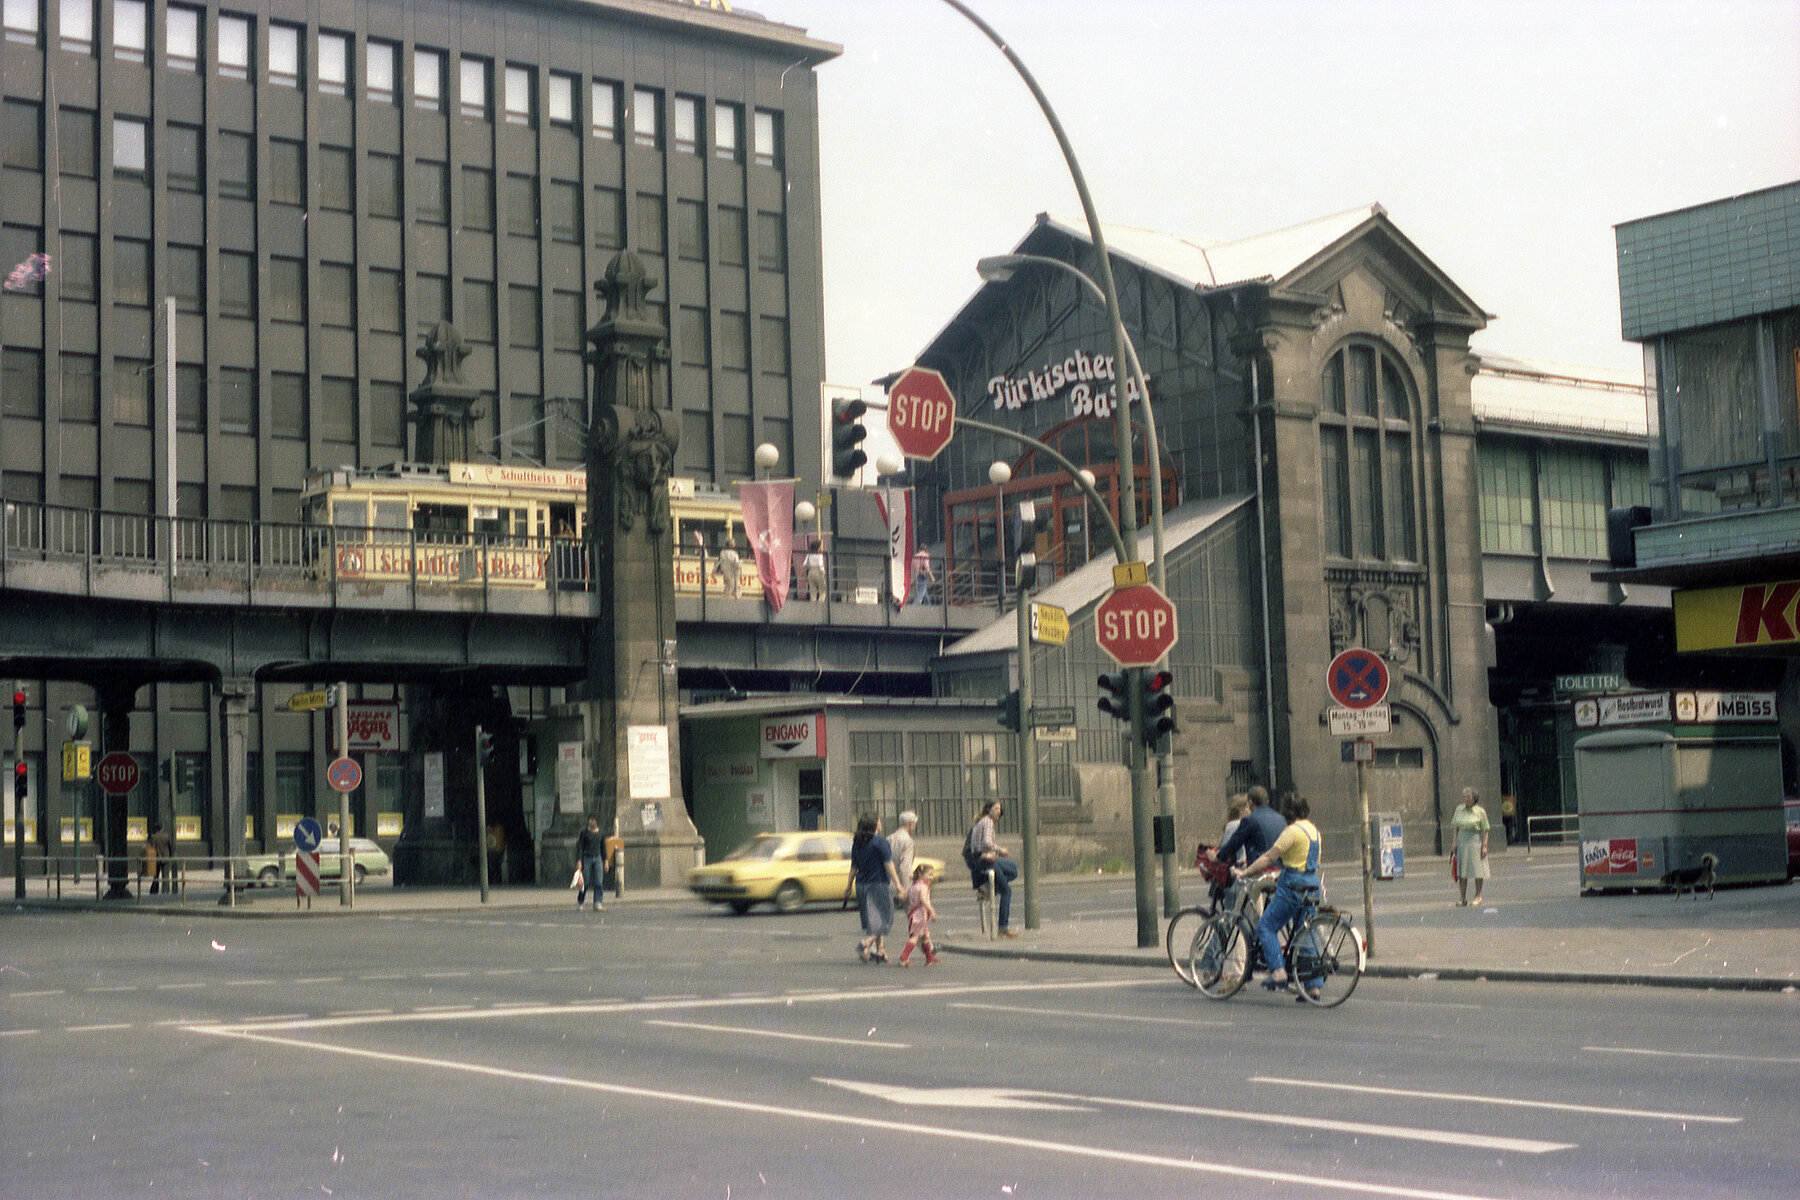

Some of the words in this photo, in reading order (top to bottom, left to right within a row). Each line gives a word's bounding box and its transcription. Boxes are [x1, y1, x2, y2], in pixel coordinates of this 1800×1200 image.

[988, 349, 1116, 410] Türkischer
[1071, 373, 1151, 418] Basa
[896, 394, 948, 434] STOP
[500, 470, 557, 484] Schultheiss
[566, 474, 587, 487] Bra
[1127, 567, 1133, 581] 1
[1033, 612, 1038, 630] 2
[1736, 583, 1800, 645] K
[1104, 609, 1167, 641] STOP
[1559, 675, 1619, 689] TOILETTEN
[1617, 696, 1663, 712] Rostbratwurst
[1717, 700, 1771, 716] IMBISS
[765, 723, 809, 742] EINGANG
[102, 764, 135, 782] STOP
